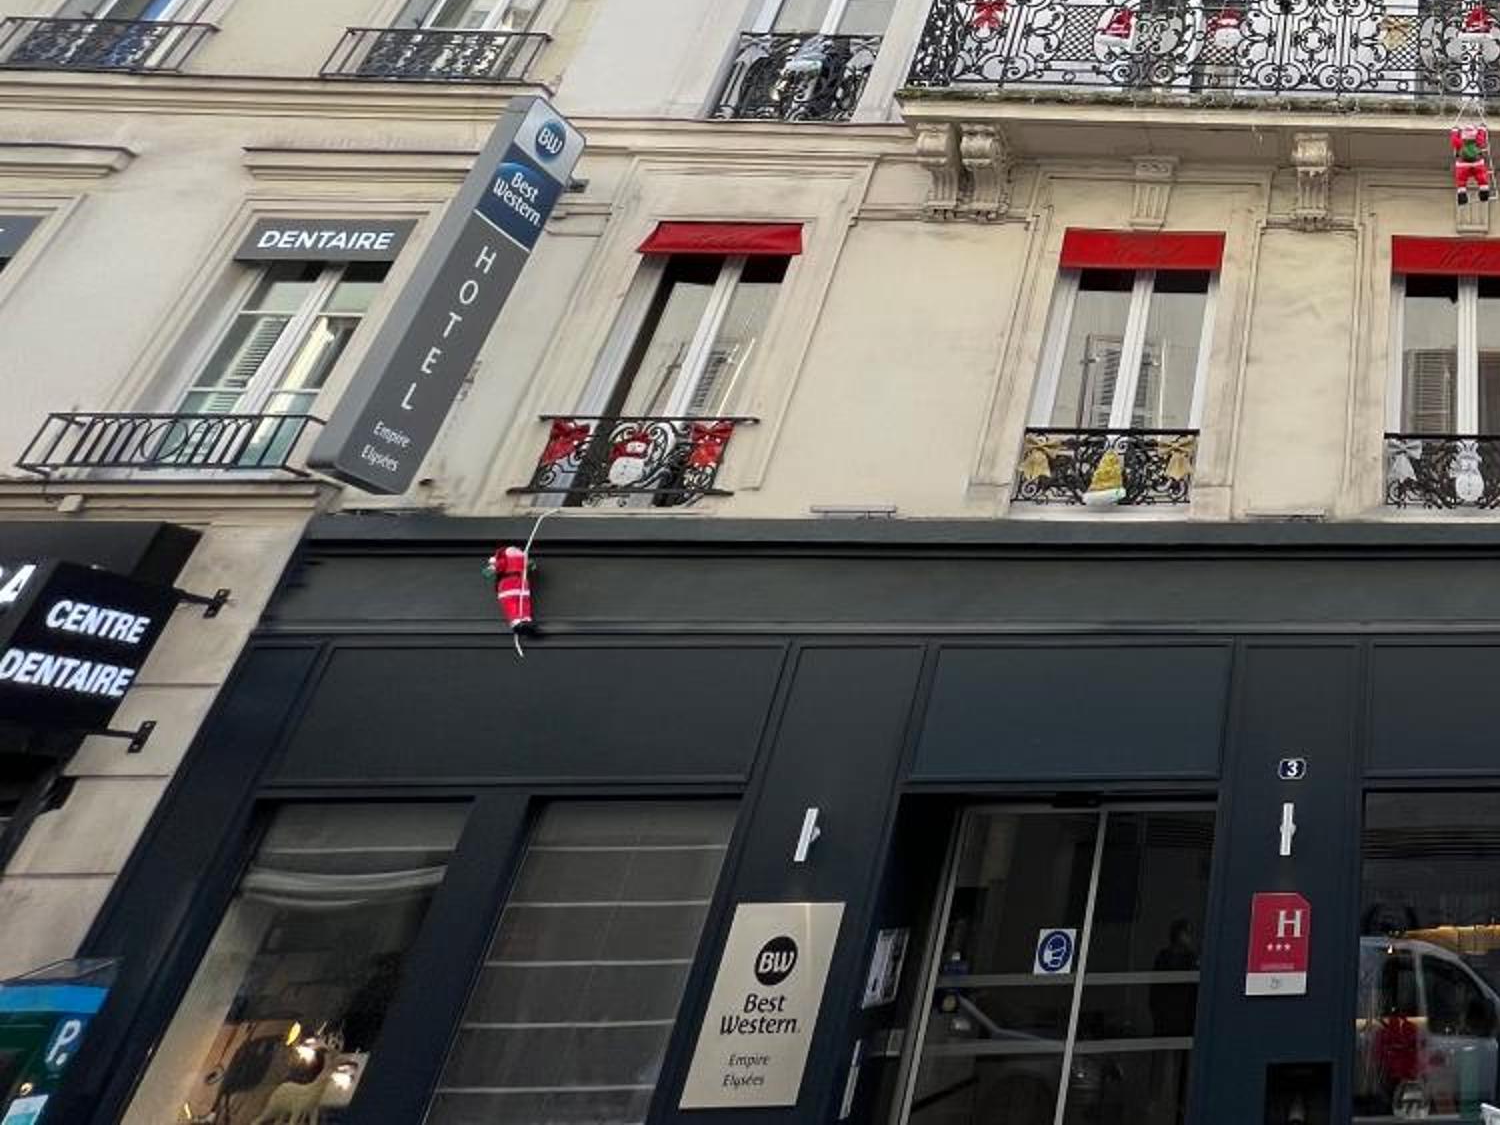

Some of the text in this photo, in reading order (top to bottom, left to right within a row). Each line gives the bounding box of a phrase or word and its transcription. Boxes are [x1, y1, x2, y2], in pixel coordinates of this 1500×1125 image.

[537, 126, 563, 154] BW
[493, 177, 541, 225] Western
[511, 172, 539, 203] Best
[257, 230, 395, 250] DENTAIRE
[401, 245, 497, 410] HOTEL
[372, 420, 412, 449] Empire
[46, 600, 150, 644] CENTRE
[0, 648, 135, 697] DENTAIRE
[1287, 760, 1298, 777] 3
[1277, 909, 1304, 938] H
[758, 950, 795, 974] BW
[743, 993, 787, 1014] Best
[720, 1015, 798, 1036] Western
[728, 1054, 771, 1067] Empire
